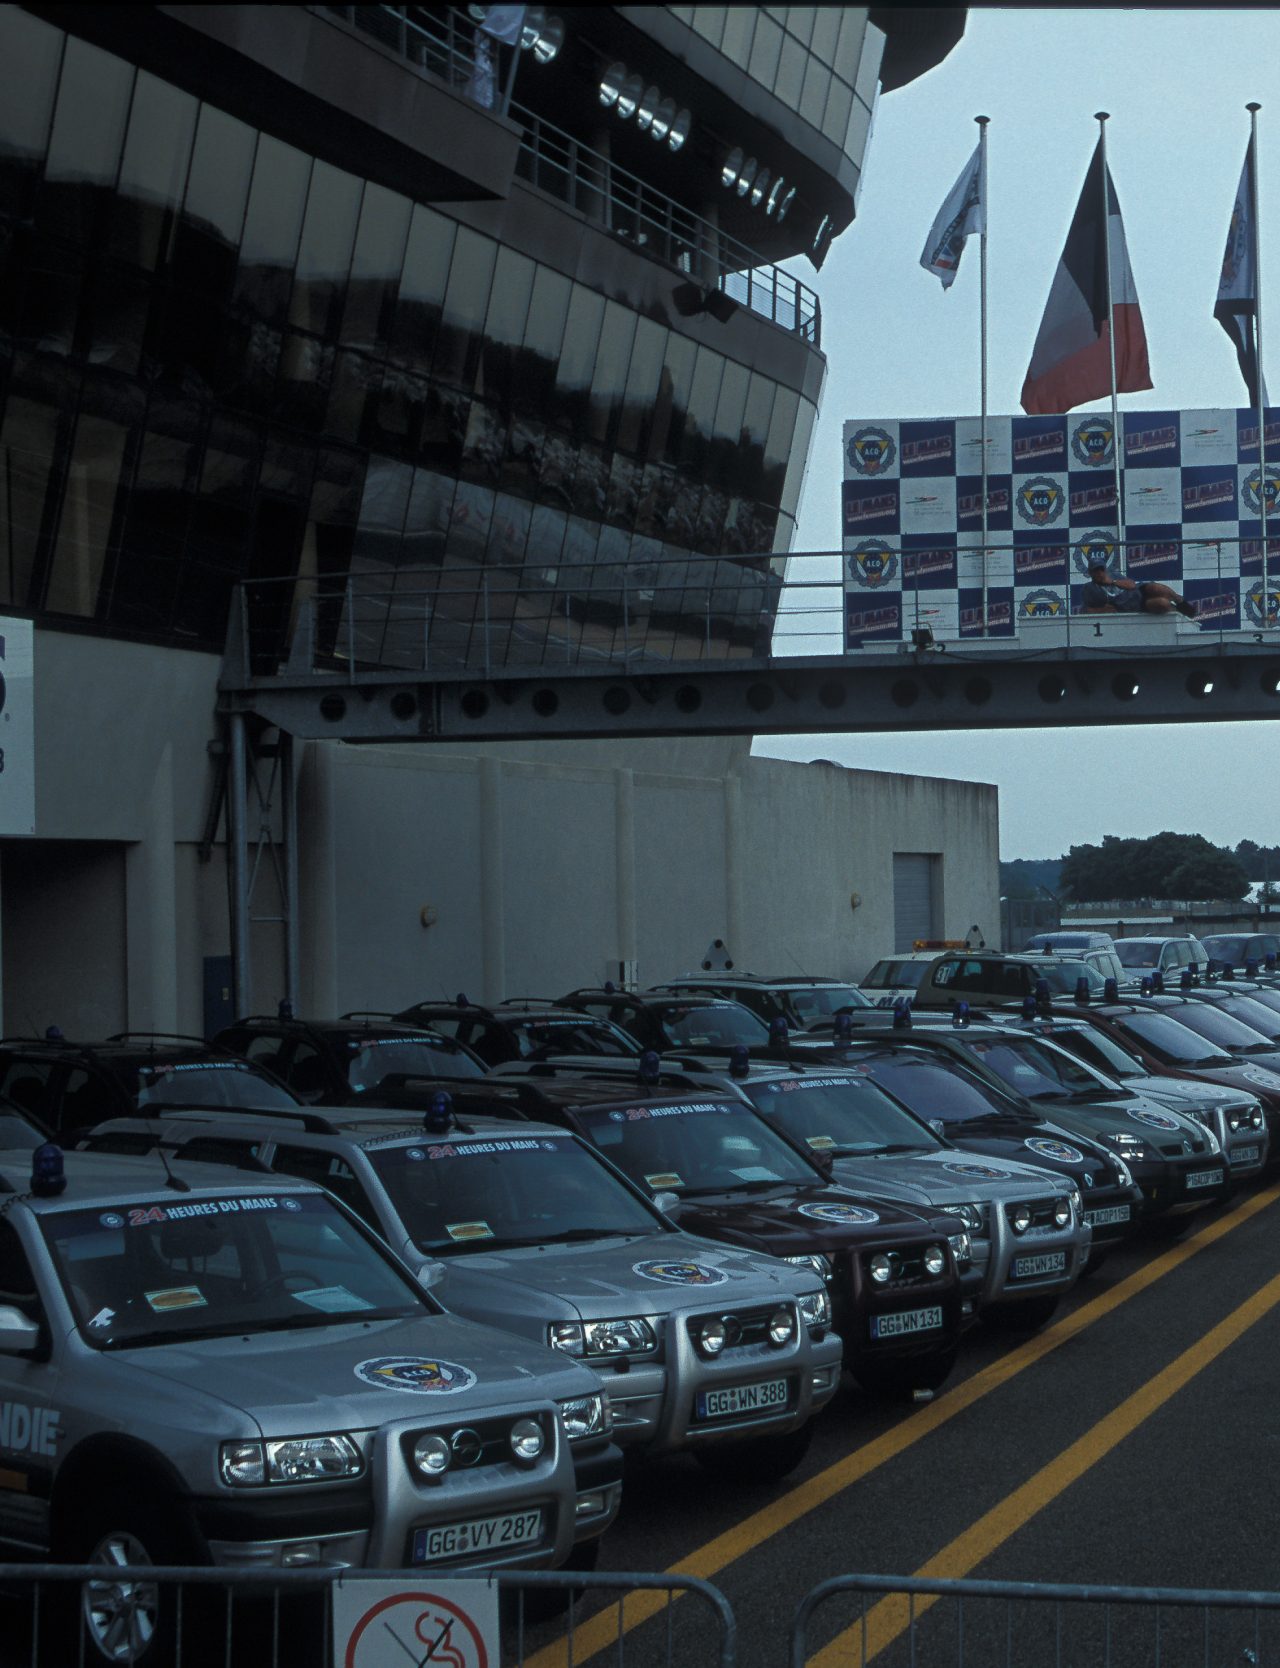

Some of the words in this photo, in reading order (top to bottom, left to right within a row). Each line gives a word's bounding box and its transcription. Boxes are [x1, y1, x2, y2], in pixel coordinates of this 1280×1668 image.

[902, 440, 915, 455] LE
[916, 435, 952, 453] MANS
[1014, 437, 1028, 453] LE
[1028, 431, 1064, 450] MANS
[1126, 433, 1140, 449] LE
[1140, 427, 1176, 446] MANS
[1239, 428, 1252, 444] LE
[1070, 490, 1084, 507] LE
[1183, 487, 1197, 501] LE
[1197, 480, 1234, 498] MANS
[847, 499, 860, 514] LE
[860, 494, 896, 512] MANS
[958, 494, 972, 511] LE
[1015, 550, 1029, 565] LE
[1029, 546, 1065, 563] MANS
[1128, 547, 1142, 562] LE
[1143, 541, 1178, 559] MANS
[1240, 540, 1254, 556] LE
[903, 555, 916, 570] LE
[917, 549, 953, 567] MANS
[848, 612, 862, 628] LE
[862, 606, 898, 623] MANS
[960, 608, 973, 624] LE
[1093, 623, 1103, 637] 1
[780, 1080, 800, 1092] 24
[798, 1080, 824, 1089] HEURES
[822, 1079, 832, 1087] DU
[831, 1078, 850, 1086] MANS
[626, 1107, 650, 1121] 24
[649, 1106, 682, 1117] HEURES
[681, 1105, 693, 1114] DU
[692, 1104, 717, 1113] MANS
[427, 1144, 458, 1160] 24
[456, 1143, 496, 1155] HEURES
[496, 1142, 511, 1151] DU
[510, 1140, 540, 1150] MANS
[128, 1206, 168, 1226] 24
[166, 1201, 217, 1219] HEURES
[218, 1200, 239, 1212] DU
[239, 1197, 278, 1210] MANS
[1017, 1260, 1029, 1275] GG
[1035, 1257, 1047, 1272] WN
[879, 1317, 895, 1335] GG
[903, 1312, 918, 1331] WN
[920, 1309, 940, 1327] 131
[708, 1392, 728, 1414] GG
[738, 1387, 757, 1408] WN
[760, 1382, 785, 1404] 388
[428, 1530, 456, 1555] GG
[471, 1521, 497, 1548] VY
[500, 1514, 538, 1542] 287
